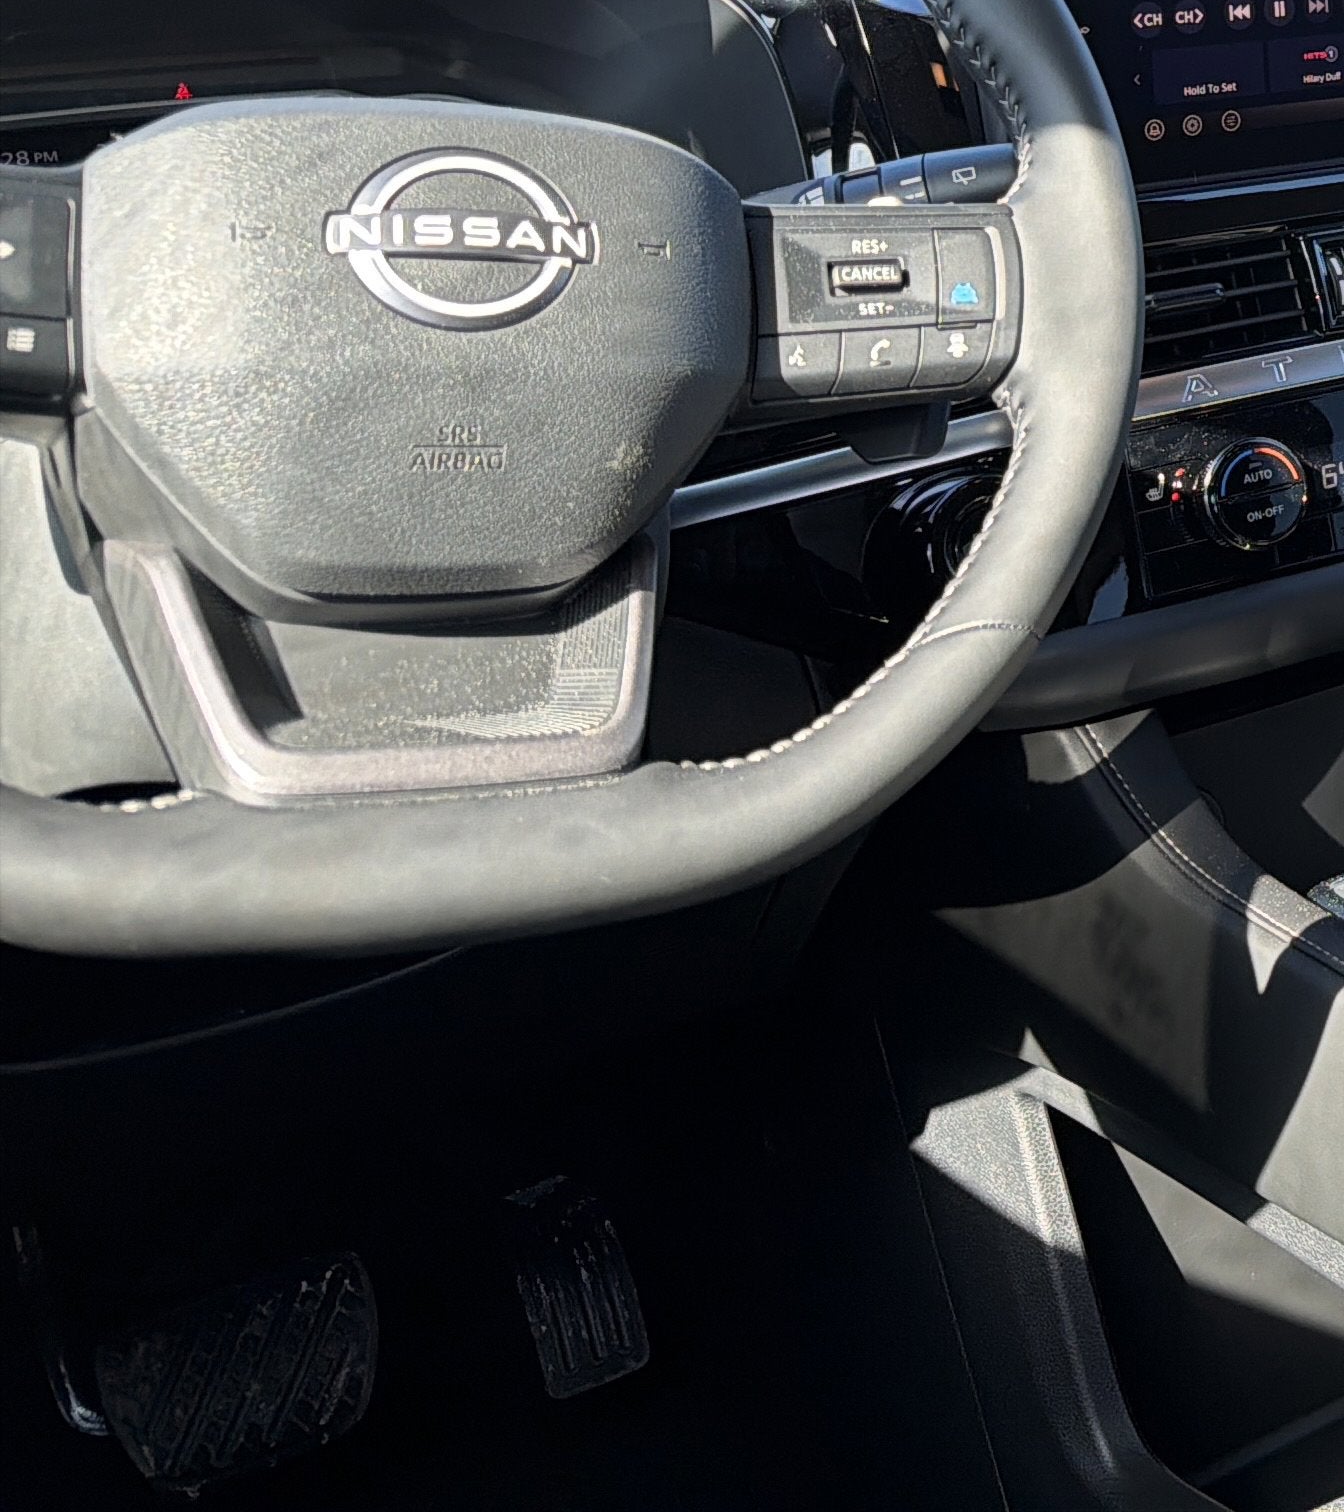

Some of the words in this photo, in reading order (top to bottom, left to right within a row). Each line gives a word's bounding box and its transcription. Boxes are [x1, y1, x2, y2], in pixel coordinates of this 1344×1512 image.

[1303, 72, 1322, 84] Hilary
[1324, 72, 1341, 82] Duff
[1184, 84, 1206, 96] Hold
[1207, 84, 1220, 94] To
[1221, 82, 1237, 93] Set
[33, 151, 59, 163] PM
[338, 214, 589, 258] NISSAN
[851, 239, 889, 255] RES+
[840, 266, 898, 281] CANCEL
[437, 424, 482, 444] SRS
[410, 448, 506, 473] AIRBAG
[1243, 469, 1273, 484] AUTO
